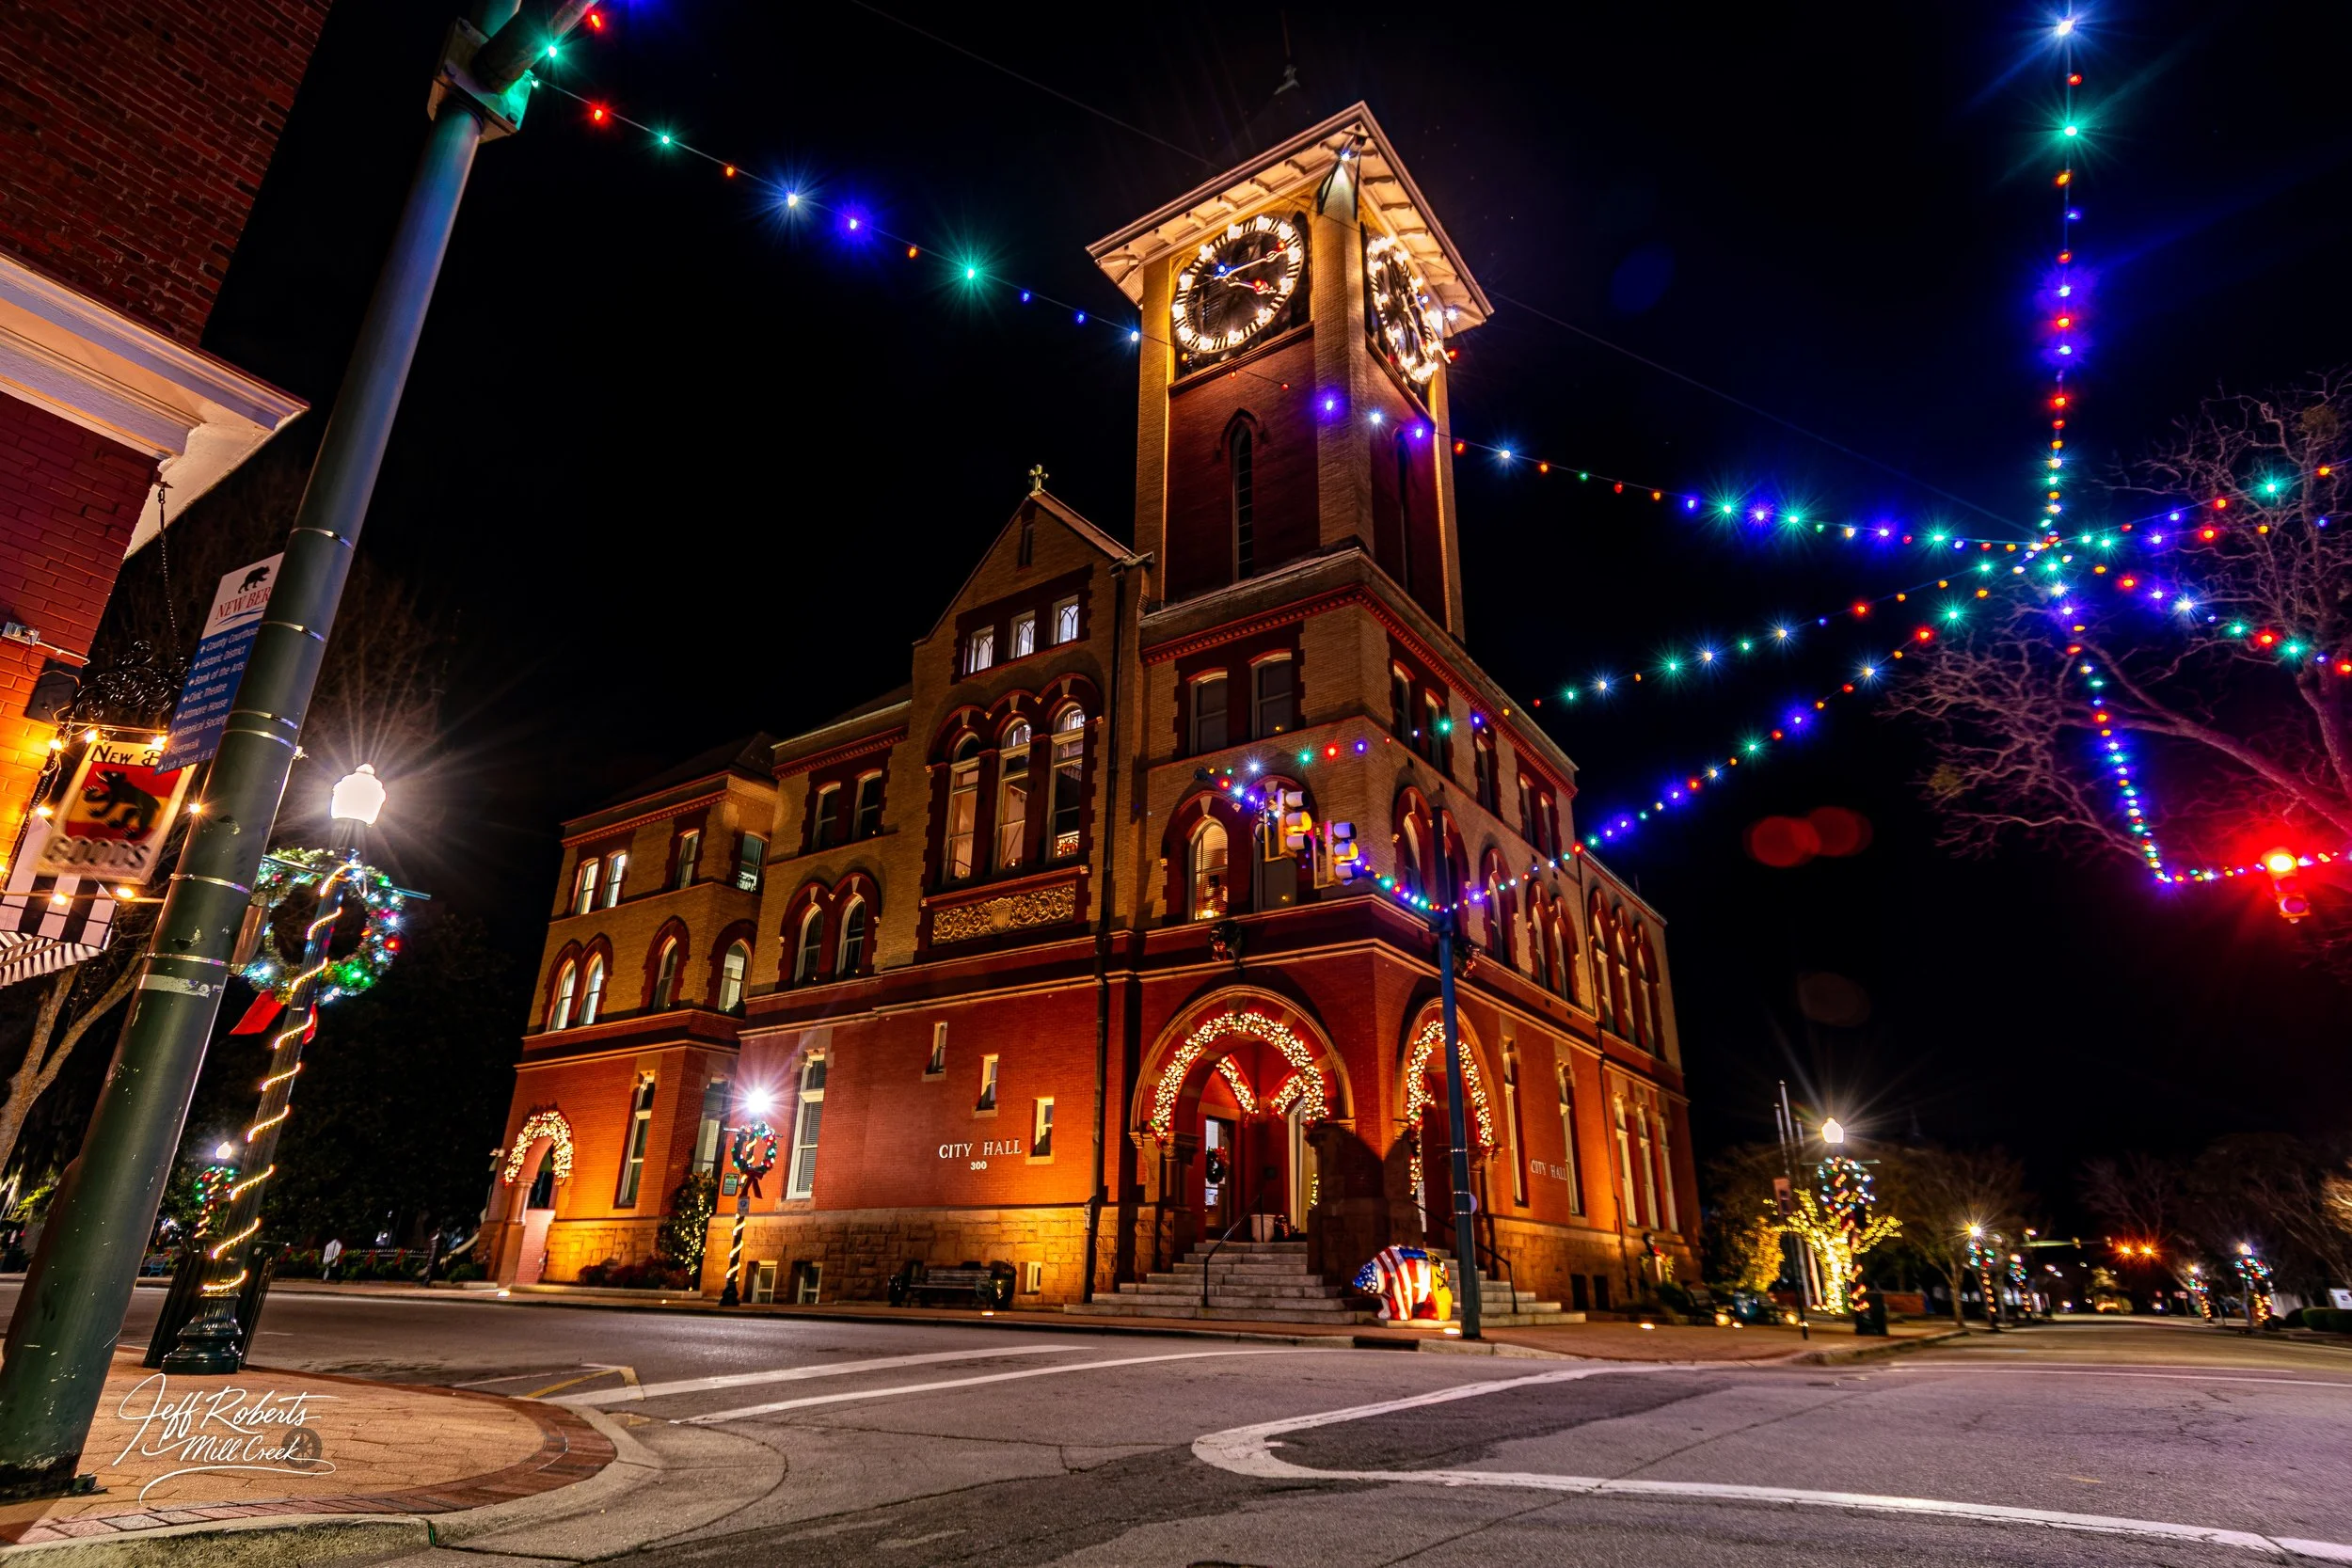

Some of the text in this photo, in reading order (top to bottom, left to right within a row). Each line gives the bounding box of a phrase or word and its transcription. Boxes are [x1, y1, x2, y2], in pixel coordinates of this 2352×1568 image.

[215, 586, 271, 620] NEW BER
[206, 626, 260, 652] County Courthous
[200, 645, 246, 669] Historic District
[194, 662, 245, 686] Bank of the Arts
[188, 683, 228, 703] Civic Theatre
[207, 699, 229, 712] House
[176, 714, 229, 737] Historical Society
[89, 745, 134, 765] New
[42, 834, 151, 870] GOODS
[938, 1139, 1023, 1159] CITY HALL
[970, 1161, 988, 1171] 300
[1531, 1159, 1567, 1180] CITY HALL
